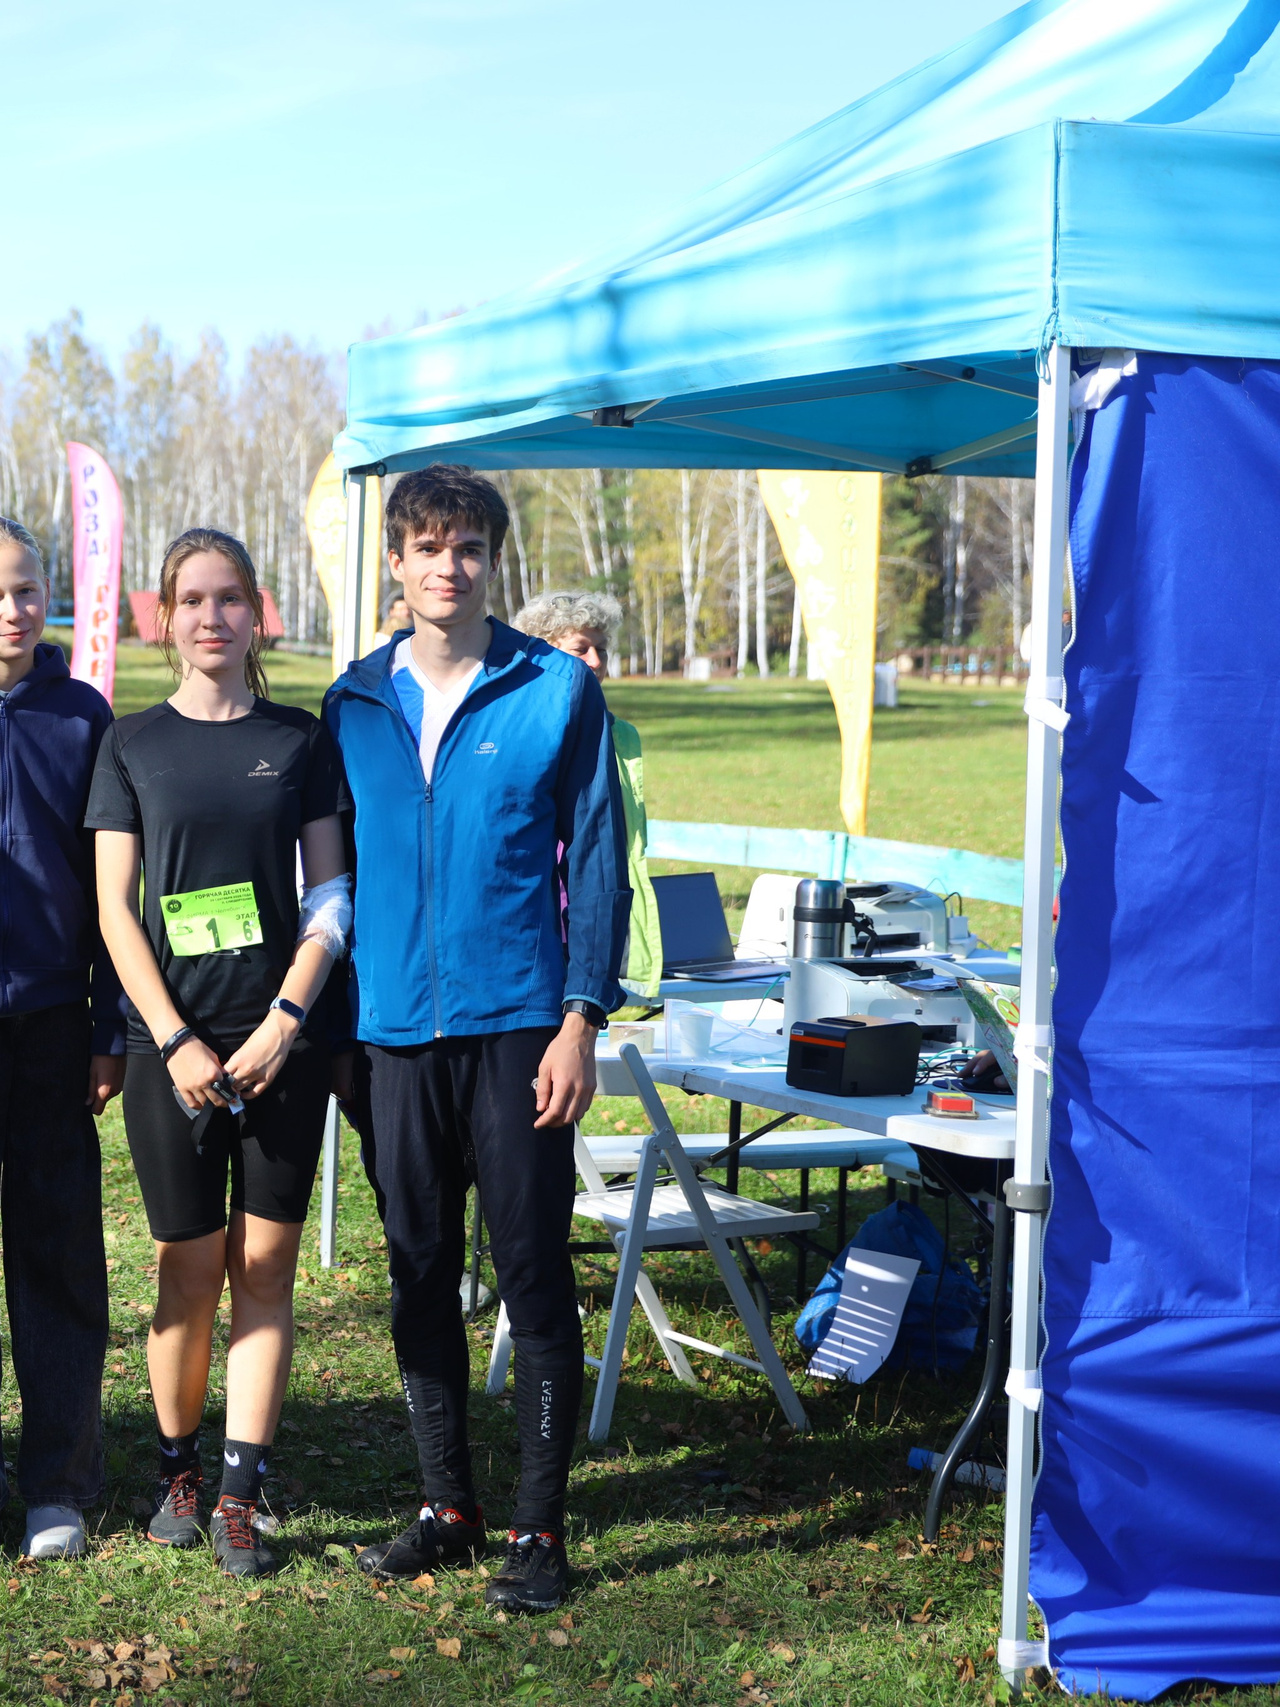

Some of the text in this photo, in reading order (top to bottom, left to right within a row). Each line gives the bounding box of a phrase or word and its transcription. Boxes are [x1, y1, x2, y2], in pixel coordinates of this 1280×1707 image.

[83, 464, 100, 557] РОЗА
[194, 887, 251, 900] ГОРЯЧАЯ ДЕСЯТКА
[235, 912, 256, 921] ЭТАП
[205, 917, 221, 949] 1
[242, 920, 254, 942] 6
[540, 1380, 553, 1440] ARSWEAR
